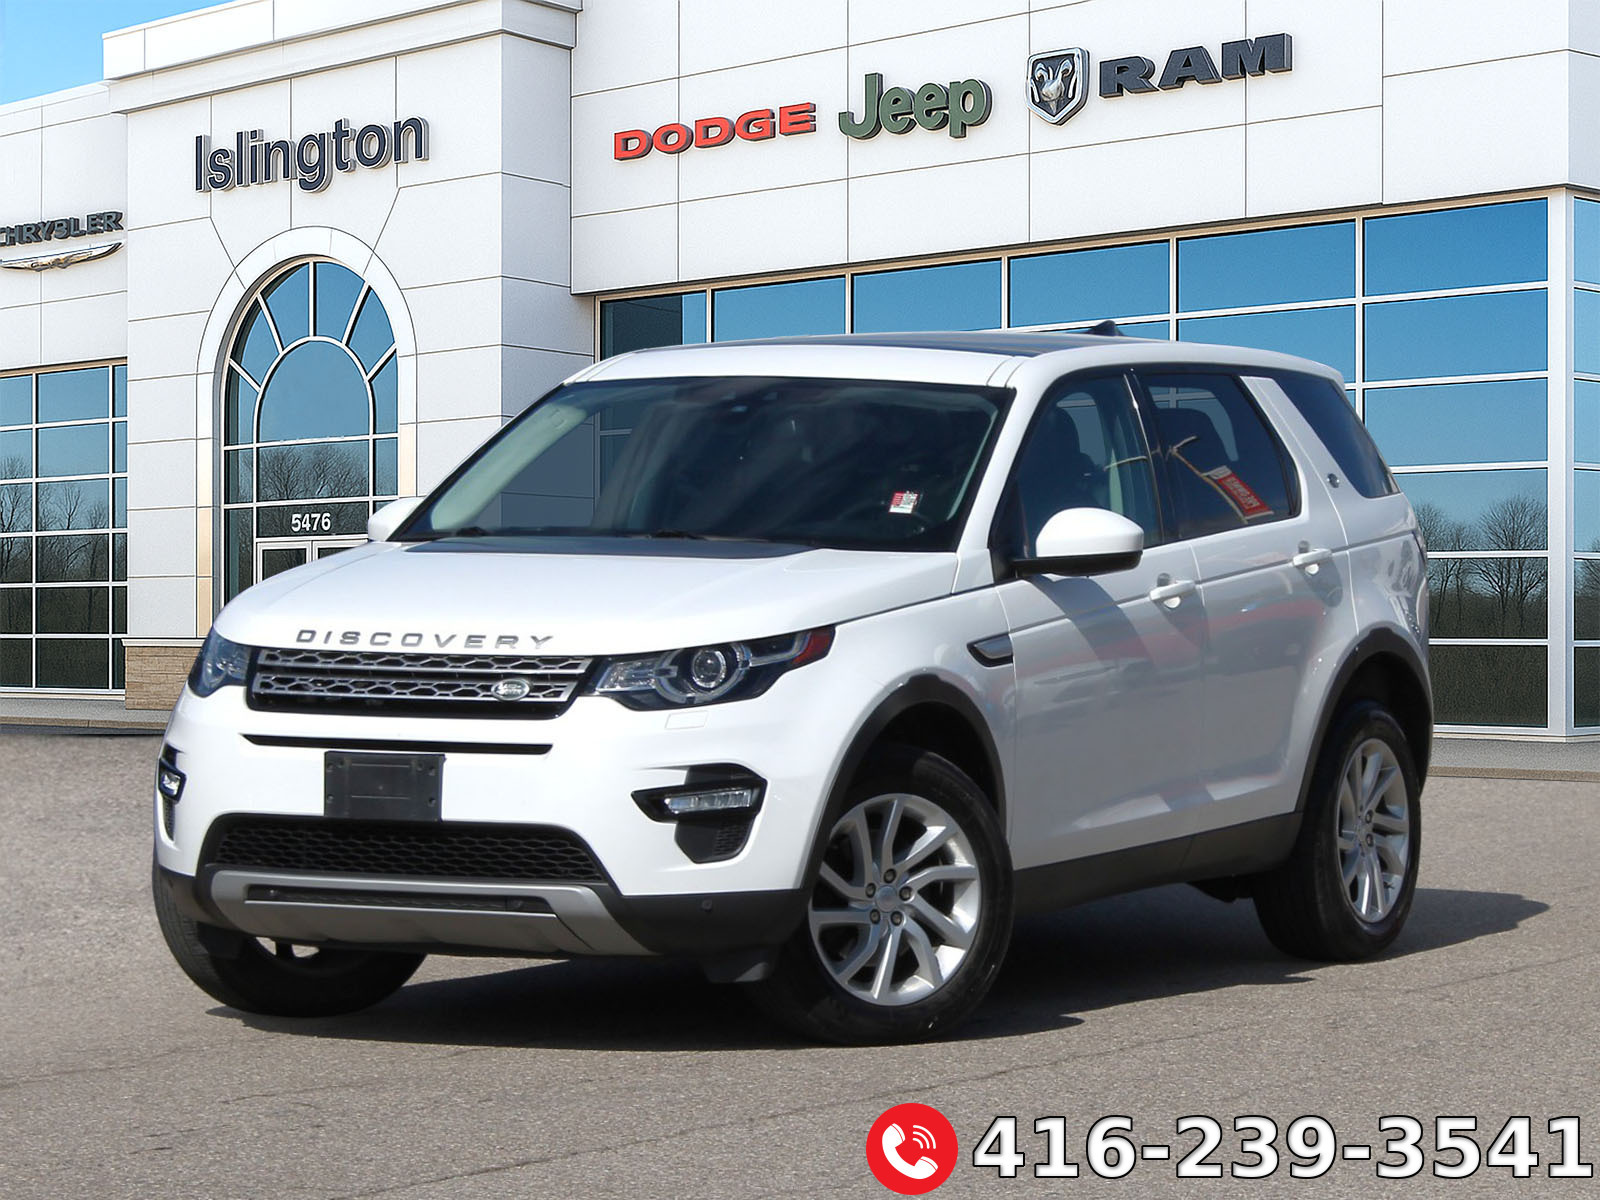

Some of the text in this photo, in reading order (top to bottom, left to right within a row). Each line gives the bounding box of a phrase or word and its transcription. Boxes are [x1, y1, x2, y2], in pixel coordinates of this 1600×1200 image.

[1100, 33, 1293, 98] RAM
[614, 102, 817, 161] DODGE
[839, 73, 992, 140] Jeep
[195, 116, 429, 192] Islington
[291, 513, 331, 532] 5476
[295, 629, 553, 649] DISCOVERY
